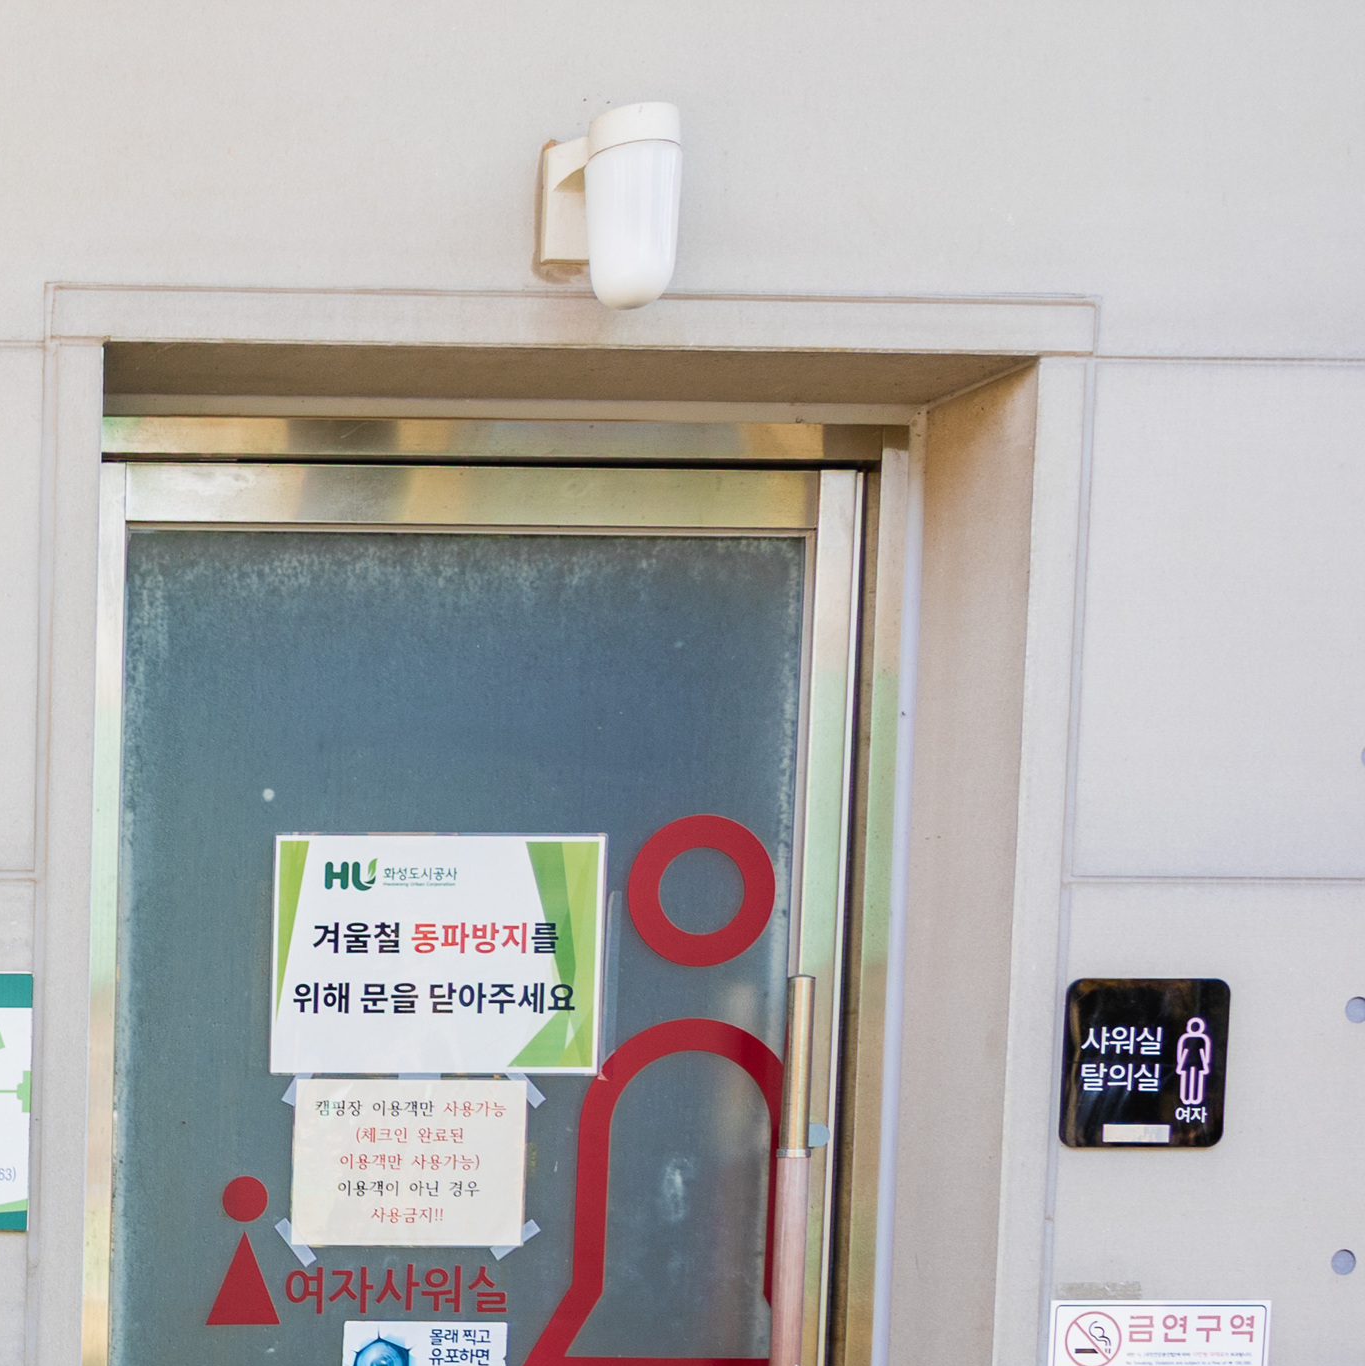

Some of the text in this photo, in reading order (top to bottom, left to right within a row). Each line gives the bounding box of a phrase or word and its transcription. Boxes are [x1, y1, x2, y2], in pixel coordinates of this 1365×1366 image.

[324, 857, 378, 891] HU
[383, 867, 458, 881] 화성도시공사
[312, 921, 559, 954] 겨울철 동파방지를
[292, 981, 576, 1014] 위해 문을 닫아주세요
[1080, 1026, 1163, 1055] 샤워실
[1080, 1062, 1160, 1092] 탈의실
[314, 1100, 507, 1118] 캠핑장 이용객만 사용가능
[1174, 1106, 1208, 1124] 여자
[355, 1127, 464, 1144] (체크인 완료된
[339, 1153, 480, 1171] 이용객만 사용가능)
[337, 1180, 480, 1197] 이용객이 아닌 경우
[370, 1207, 444, 1224] 사용금지!!
[429, 1328, 491, 1346] 몰래 찍고
[1128, 1314, 1255, 1343] 금연구역
[428, 1348, 490, 1366] 유포하면
